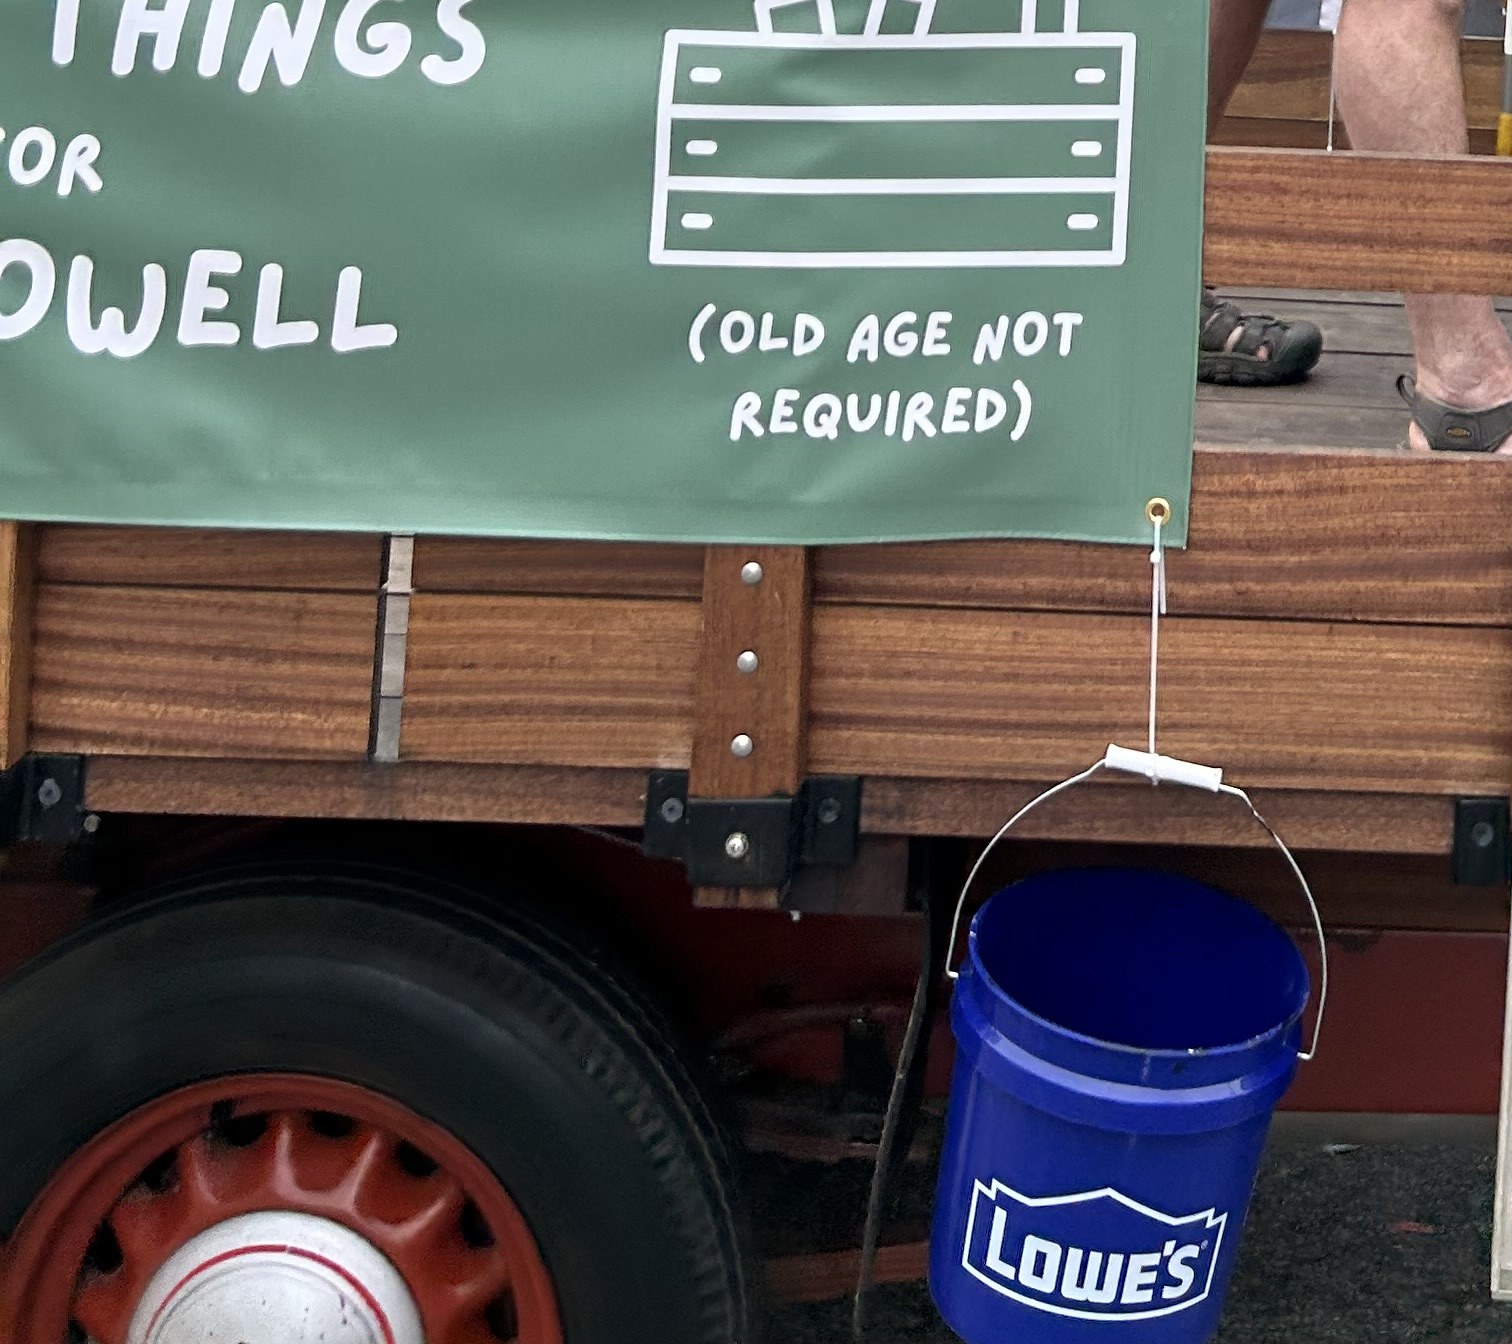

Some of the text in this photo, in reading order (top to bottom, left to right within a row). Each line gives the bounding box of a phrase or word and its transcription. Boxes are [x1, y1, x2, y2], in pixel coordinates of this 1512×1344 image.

[0, 125, 103, 197] OR
[0, 237, 398, 359] OWELL
[688, 303, 1084, 366] (OLD AGE NOT
[729, 383, 1033, 443] REQUIRED)
[985, 1205, 1200, 1304] LOWE'S
